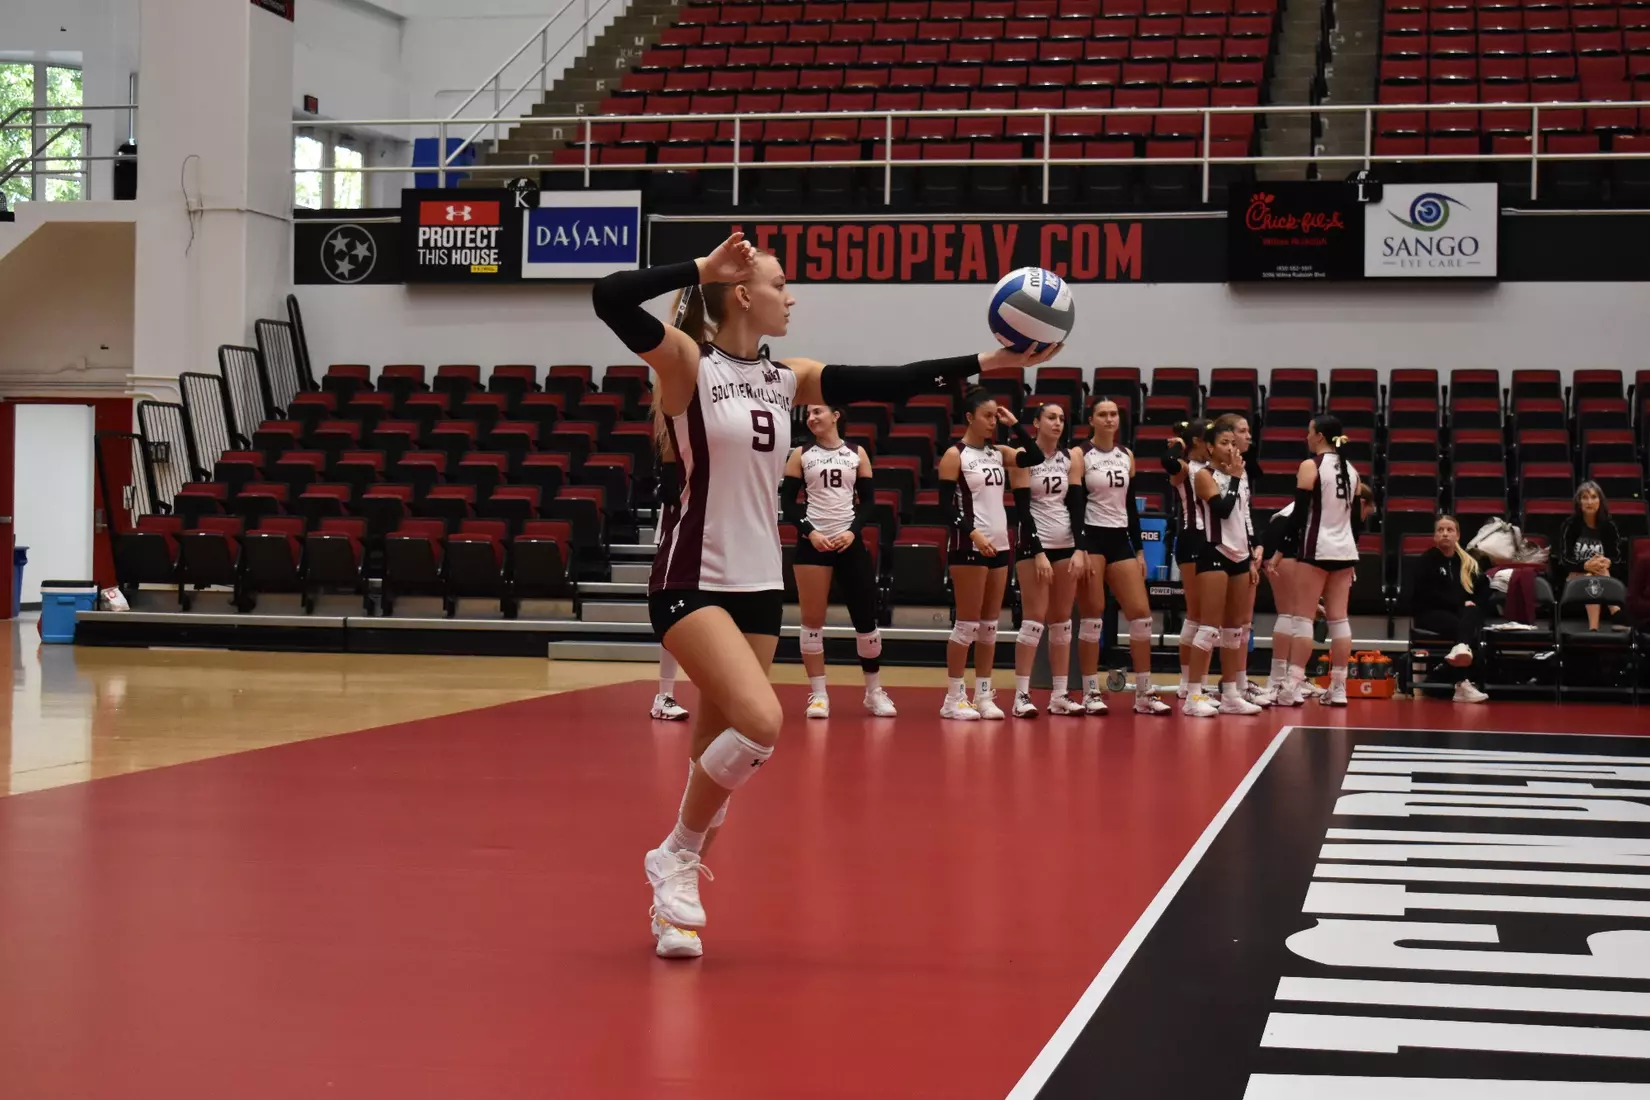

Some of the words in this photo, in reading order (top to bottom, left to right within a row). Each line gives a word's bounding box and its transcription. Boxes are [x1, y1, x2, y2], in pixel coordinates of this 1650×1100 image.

[514, 190, 530, 208] K
[1357, 183, 1370, 201] L
[1246, 200, 1345, 231] Chick-fil-A
[418, 226, 500, 247] PROTECT
[536, 220, 629, 251] DASANI
[731, 222, 1143, 280] ETSGOPEAYCOM
[1382, 236, 1479, 257] SANGO
[417, 249, 448, 265] THIS
[451, 249, 502, 265] HOUSE.
[1400, 260, 1423, 268] EYE
[1428, 260, 1463, 268] CARE
[750, 409, 776, 453] 9
[820, 468, 842, 488] 18
[981, 467, 1004, 487] 20
[1042, 476, 1062, 495] 12
[1106, 470, 1124, 488] 15
